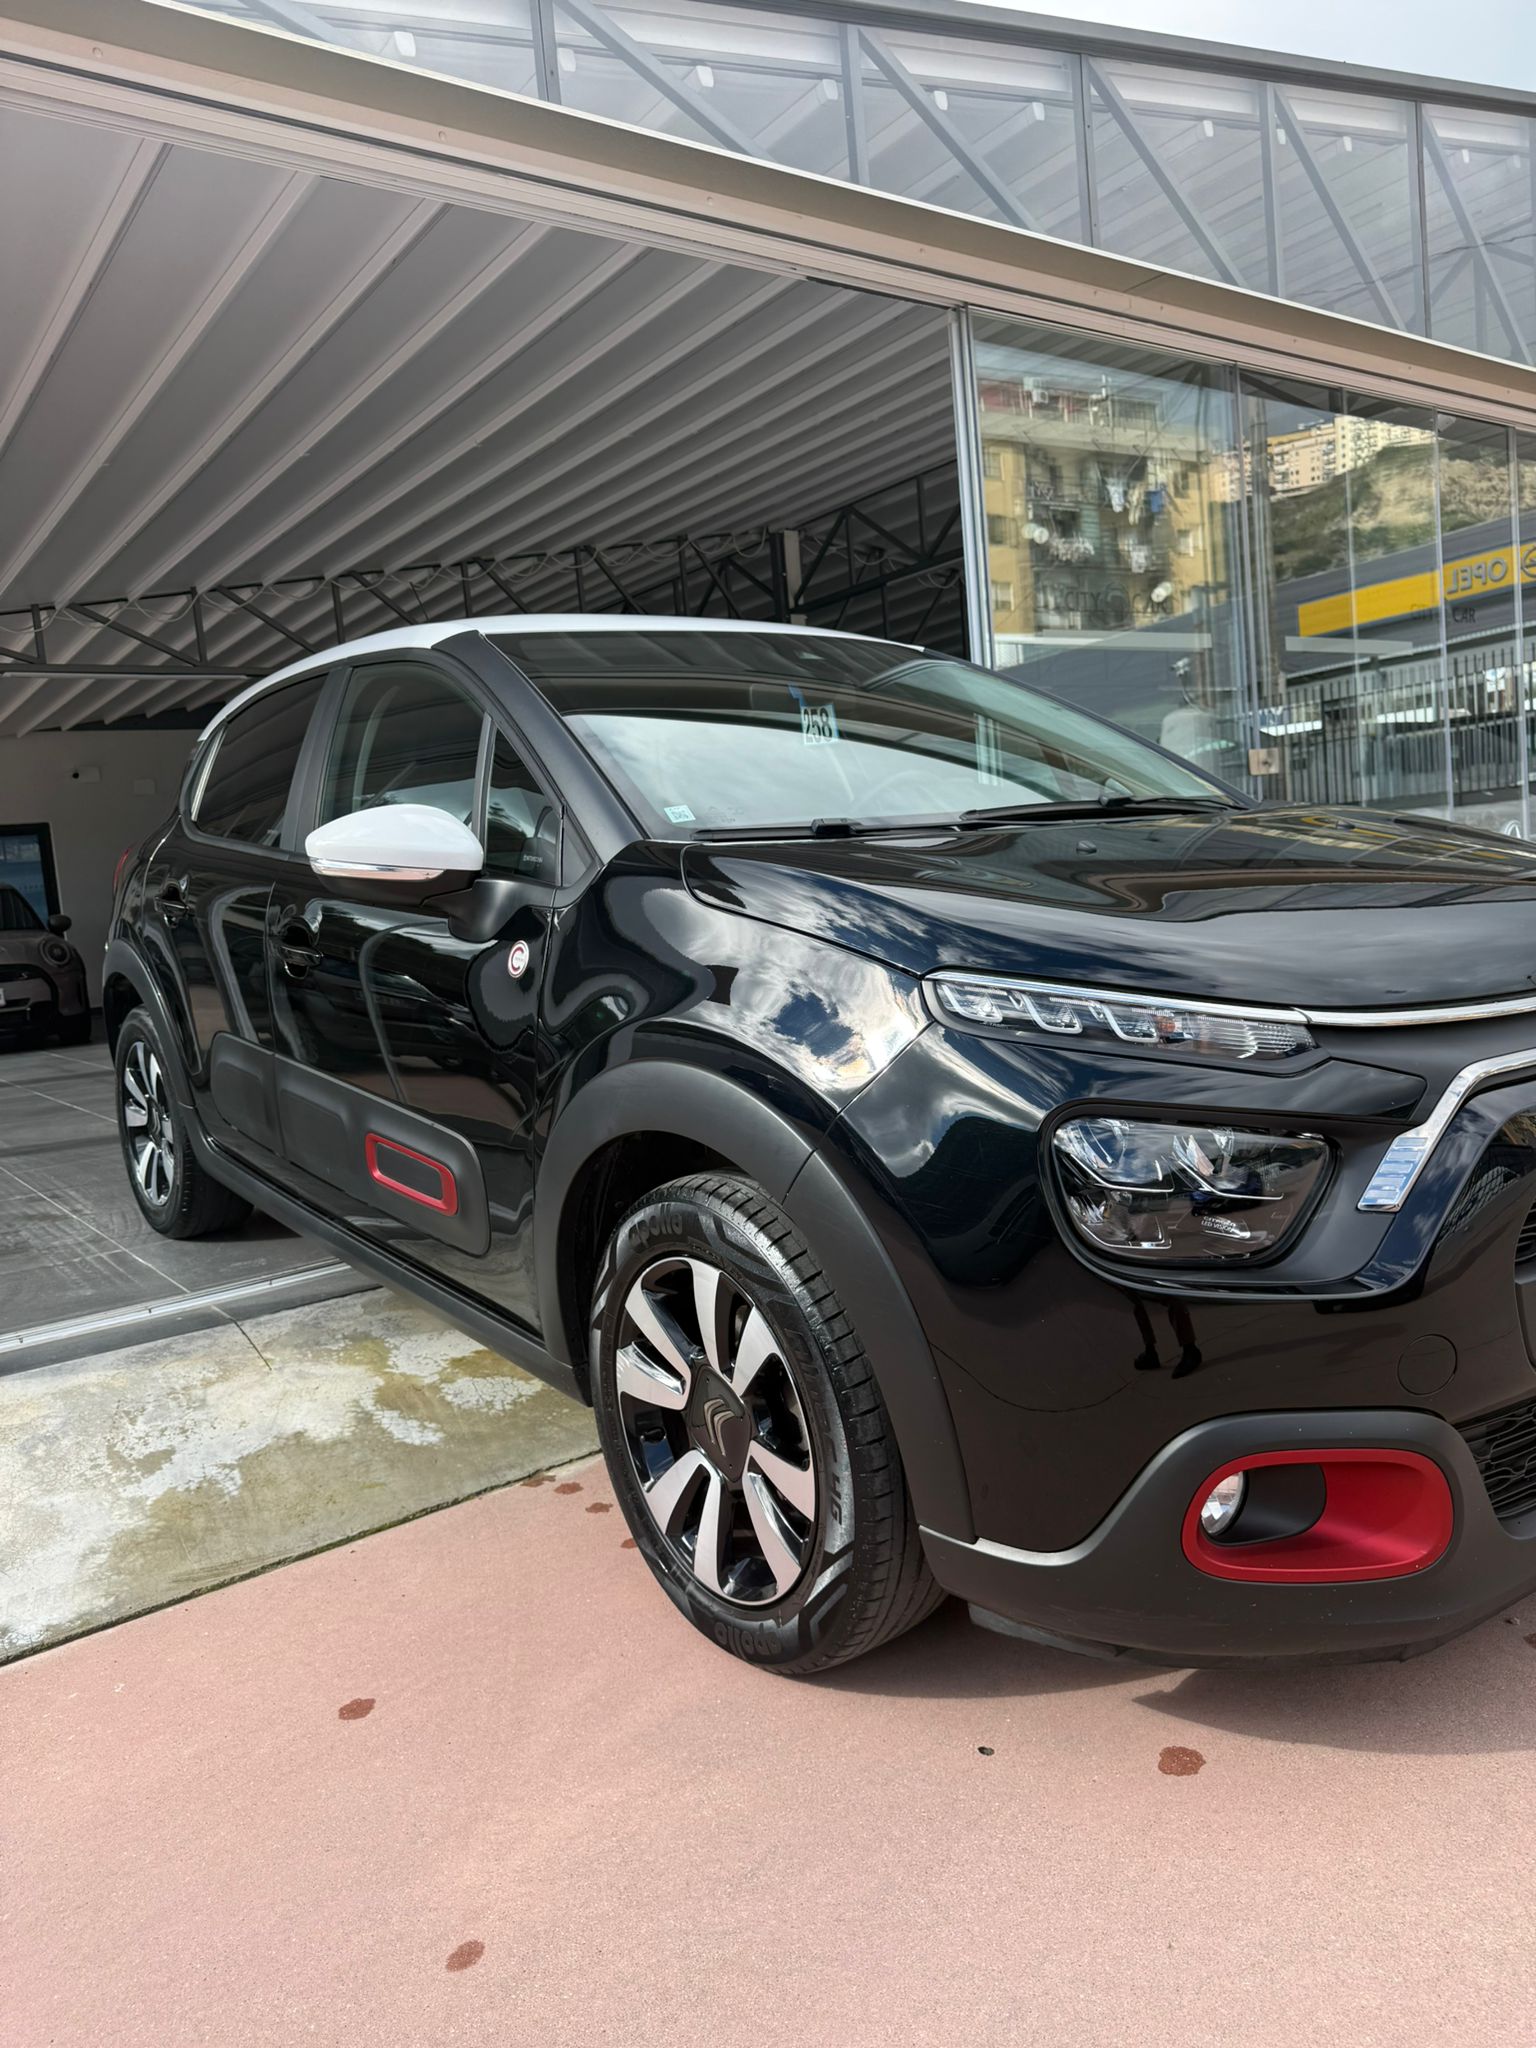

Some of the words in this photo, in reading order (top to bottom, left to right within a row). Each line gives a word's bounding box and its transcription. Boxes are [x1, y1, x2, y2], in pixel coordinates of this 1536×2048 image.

[1064, 591, 1102, 612] CITY
[1452, 606, 1476, 624] CAR
[803, 707, 833, 743] 258
[628, 1202, 683, 1252] apollo
[714, 1621, 782, 1660] apollo
